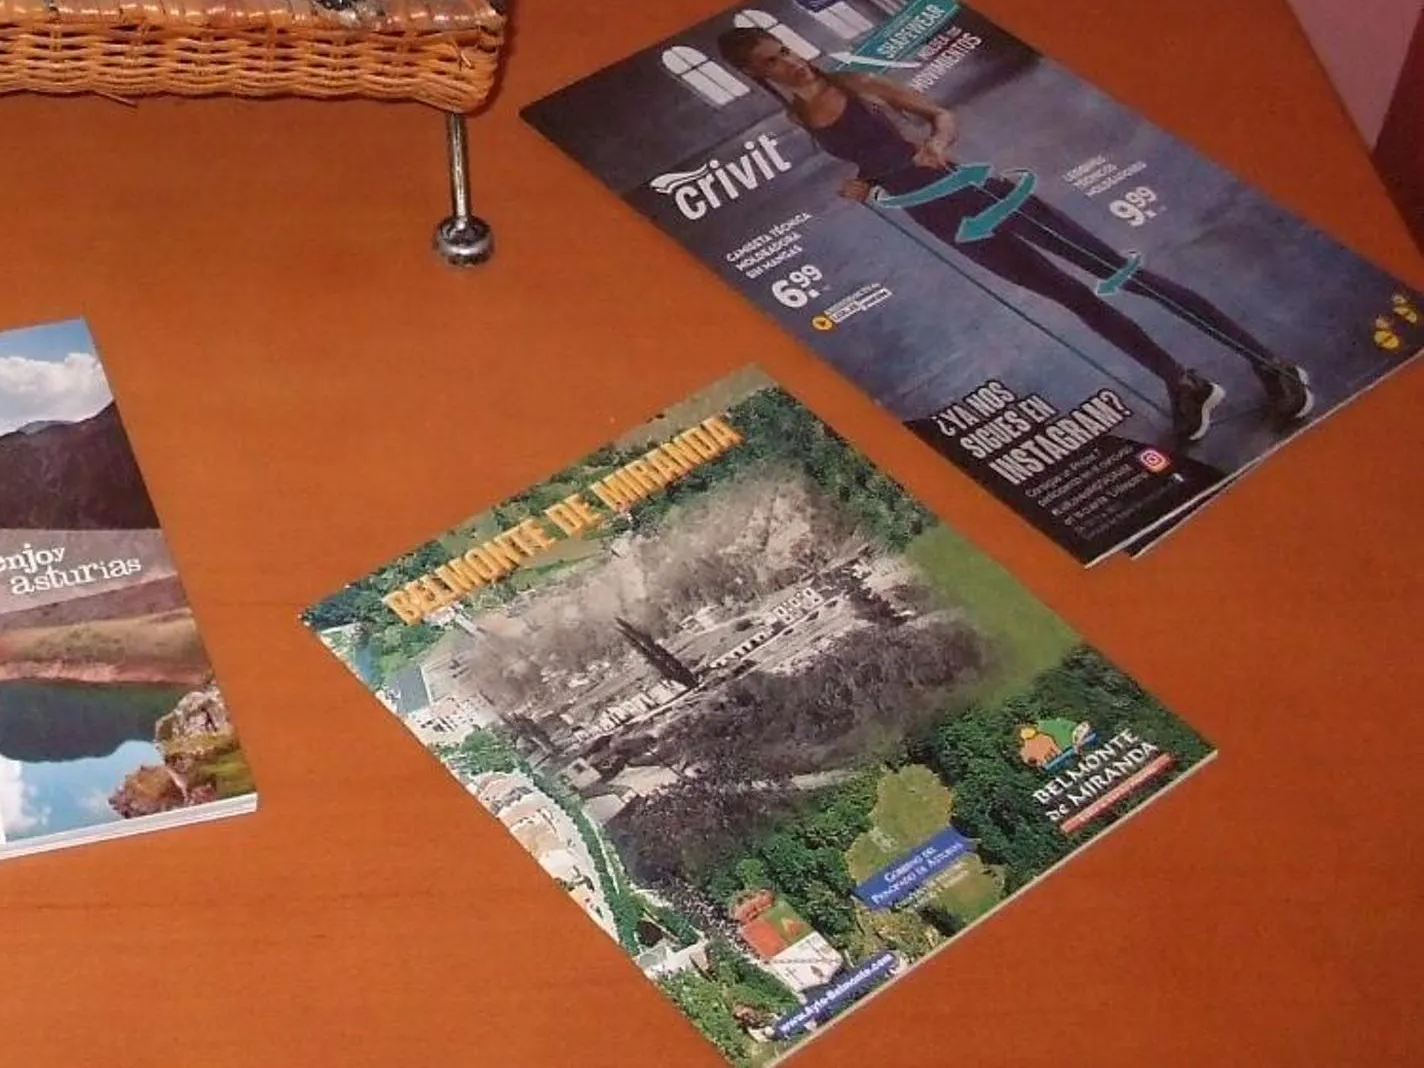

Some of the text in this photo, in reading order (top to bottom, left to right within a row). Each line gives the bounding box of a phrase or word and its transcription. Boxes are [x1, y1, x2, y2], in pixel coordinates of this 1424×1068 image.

[674, 133, 793, 221] crivit
[960, 394, 1058, 459] SIGUES EN
[963, 381, 1015, 419] NOS
[988, 389, 1132, 486] INSTAGRAM?
[381, 415, 746, 626] BELMONTE DE MIRANDA
[10, 556, 142, 596] asturias
[1032, 728, 1140, 806] BELMONTE
[1065, 740, 1160, 808] MIRANDA
